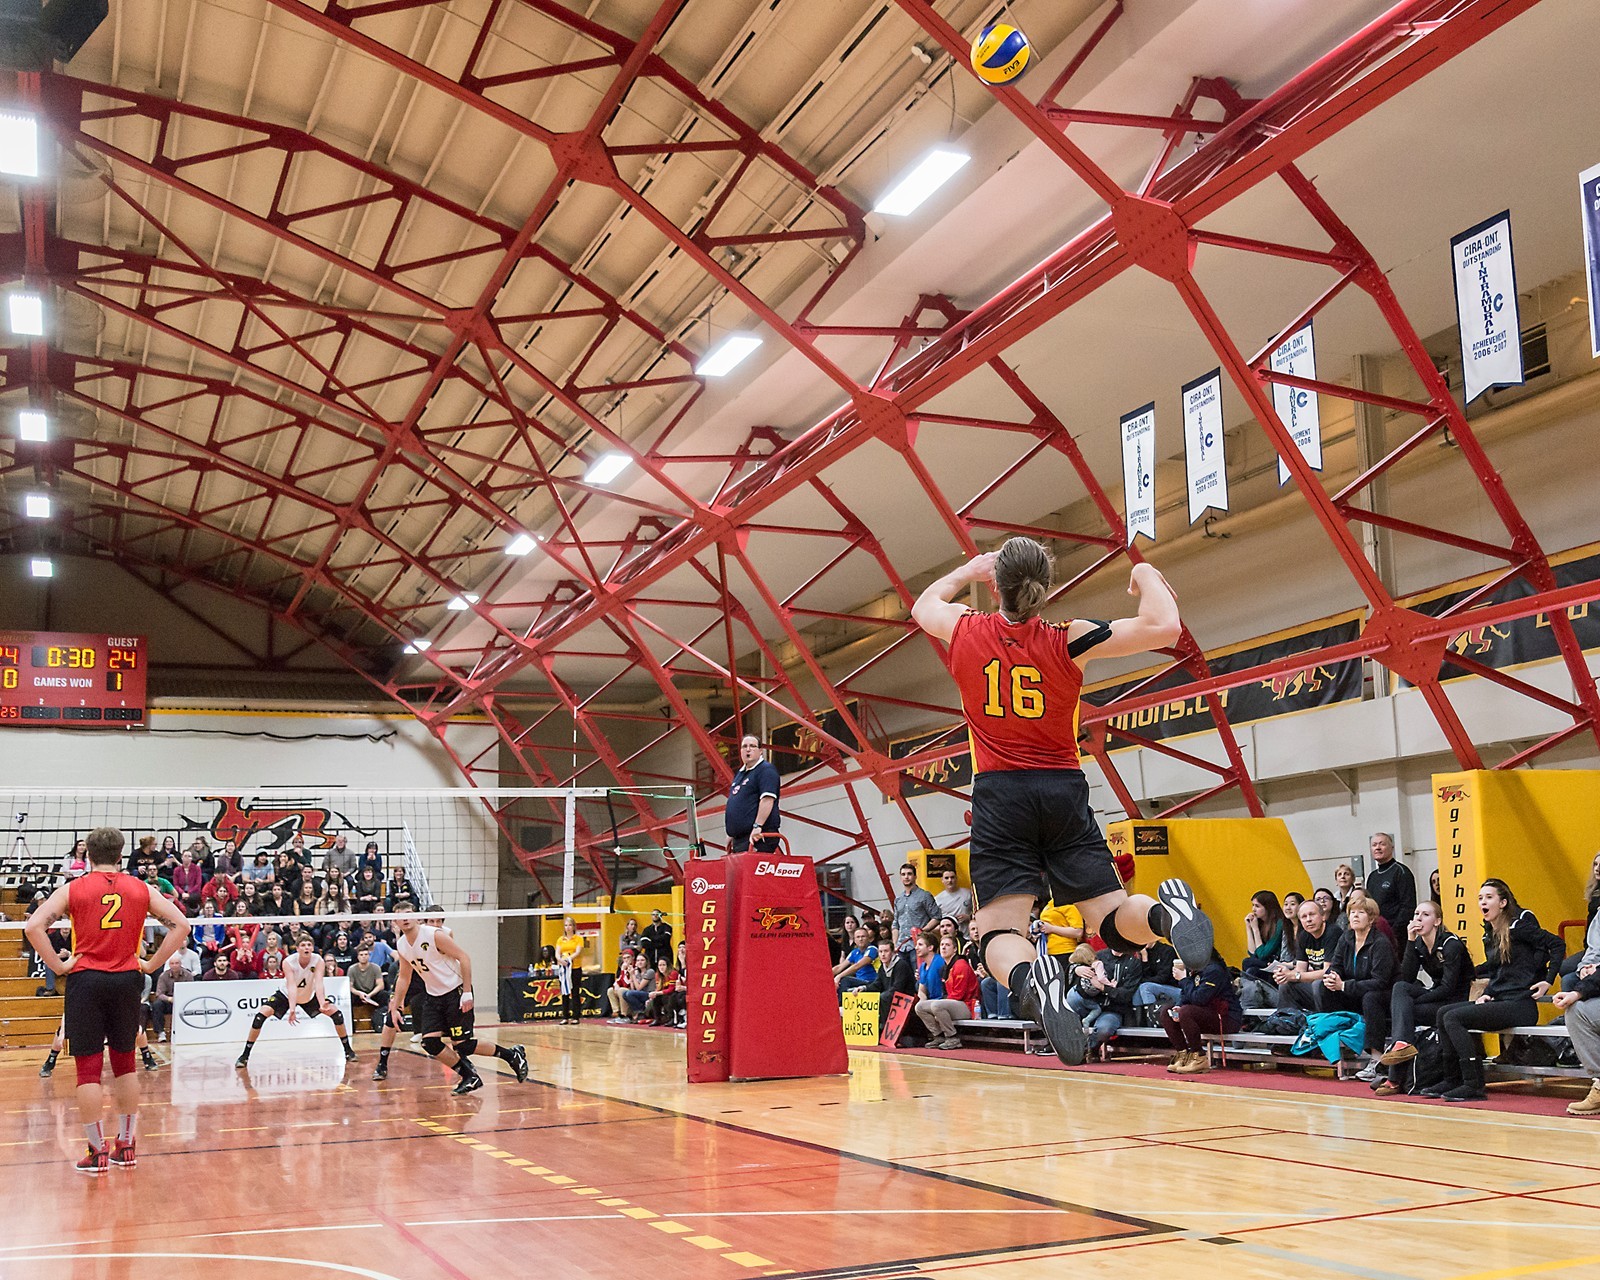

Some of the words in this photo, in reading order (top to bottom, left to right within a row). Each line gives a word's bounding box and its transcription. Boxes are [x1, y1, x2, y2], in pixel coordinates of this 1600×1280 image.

[1463, 243, 1501, 269] OUTSTANDING
[1478, 261, 1494, 336] INTRAMURAL
[1472, 330, 1506, 351] ACHIEVEMENT
[1276, 346, 1308, 367] OUTSTANDING
[108, 637, 138, 647] GUEST
[48, 647, 95, 668] 0:30
[109, 650, 136, 668] 24
[3, 668, 18, 688] 0
[34, 677, 67, 687] GAMES
[70, 678, 93, 688] WON
[116, 673, 122, 690] 1
[983, 657, 1045, 719] 16
[0, 706, 17, 718] 25
[101, 893, 122, 929] 2
[701, 900, 717, 1043] GRYPHONS
[450, 1027, 462, 1036] 13
[845, 1023, 873, 1036] HARDER
